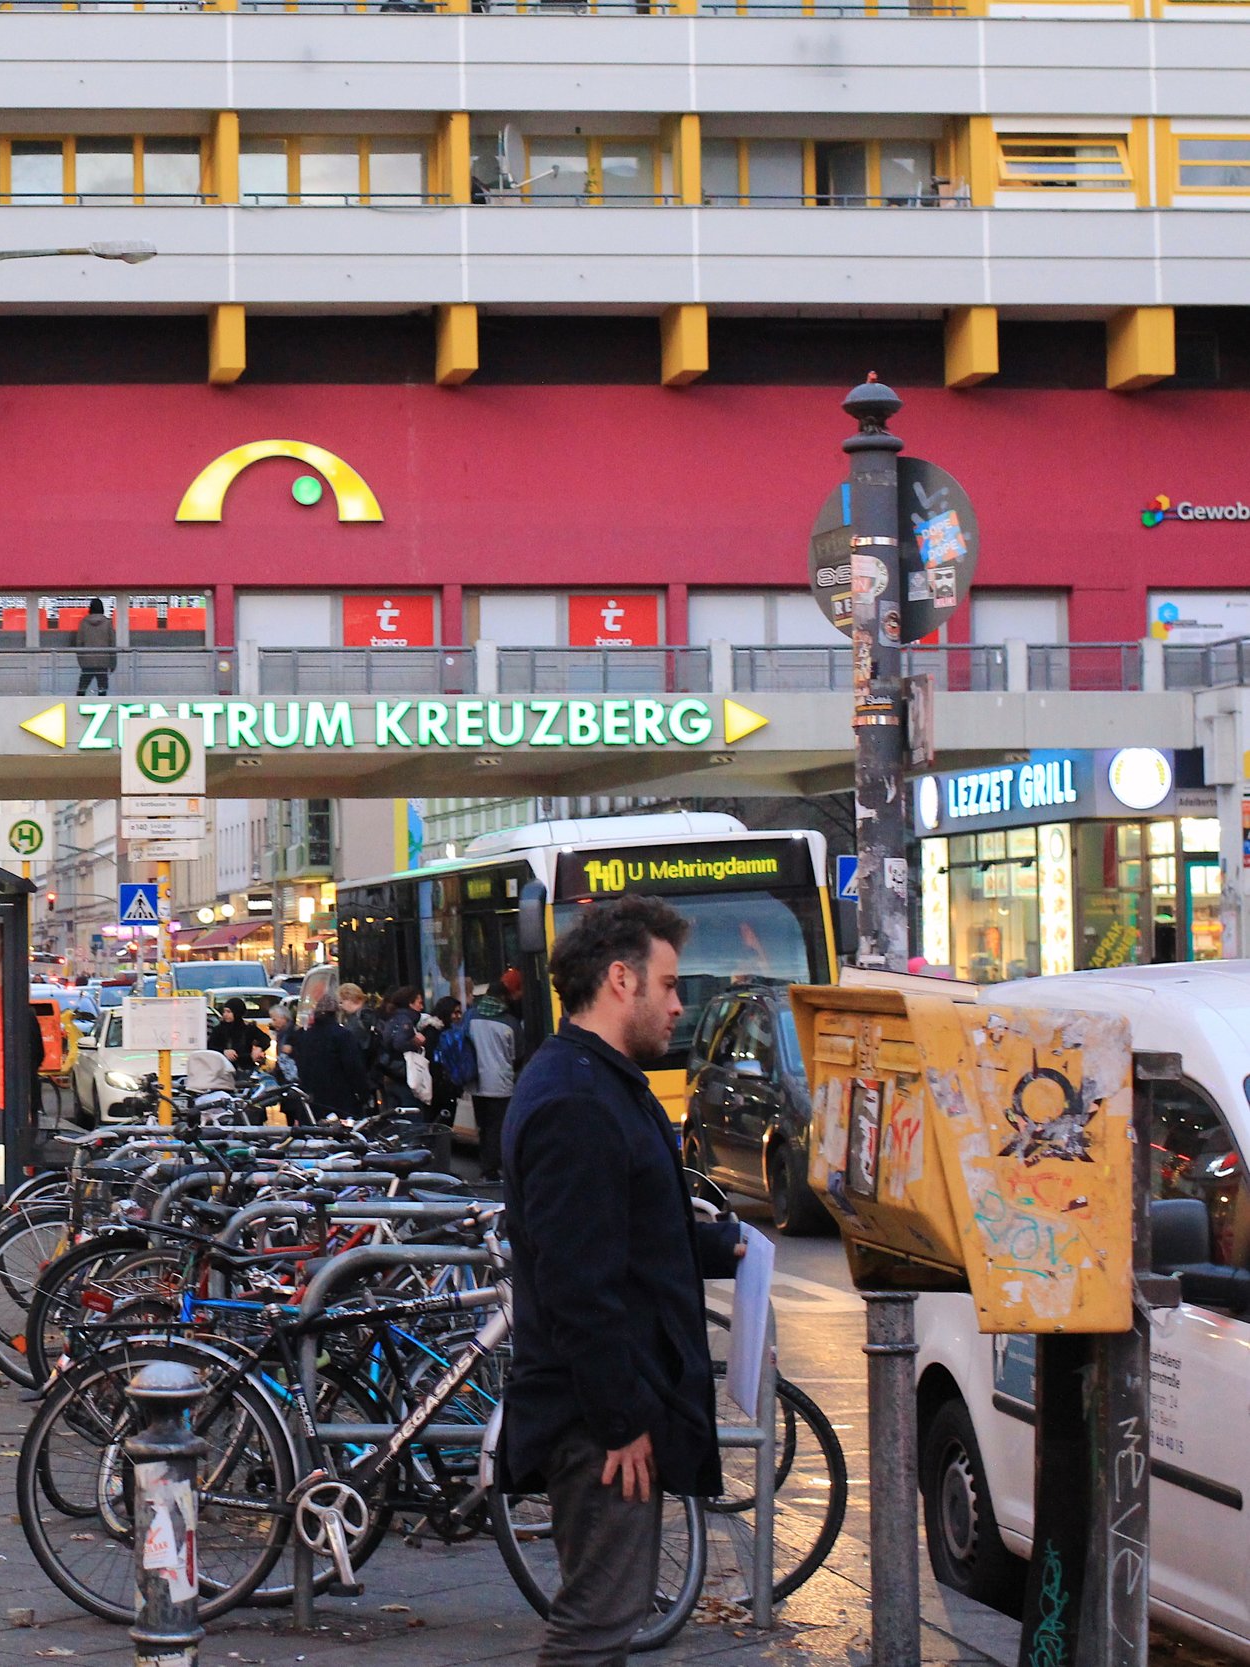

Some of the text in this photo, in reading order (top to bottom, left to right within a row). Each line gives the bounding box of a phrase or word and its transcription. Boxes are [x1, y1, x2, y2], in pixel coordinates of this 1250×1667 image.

[1177, 501, 1250, 520] Gewob
[376, 698, 713, 748] KREUZBERG
[948, 759, 1077, 819] LEZZET GRILL
[584, 855, 778, 893] 140 U Mehringdamm
[390, 1350, 474, 1451] PEGASUS
